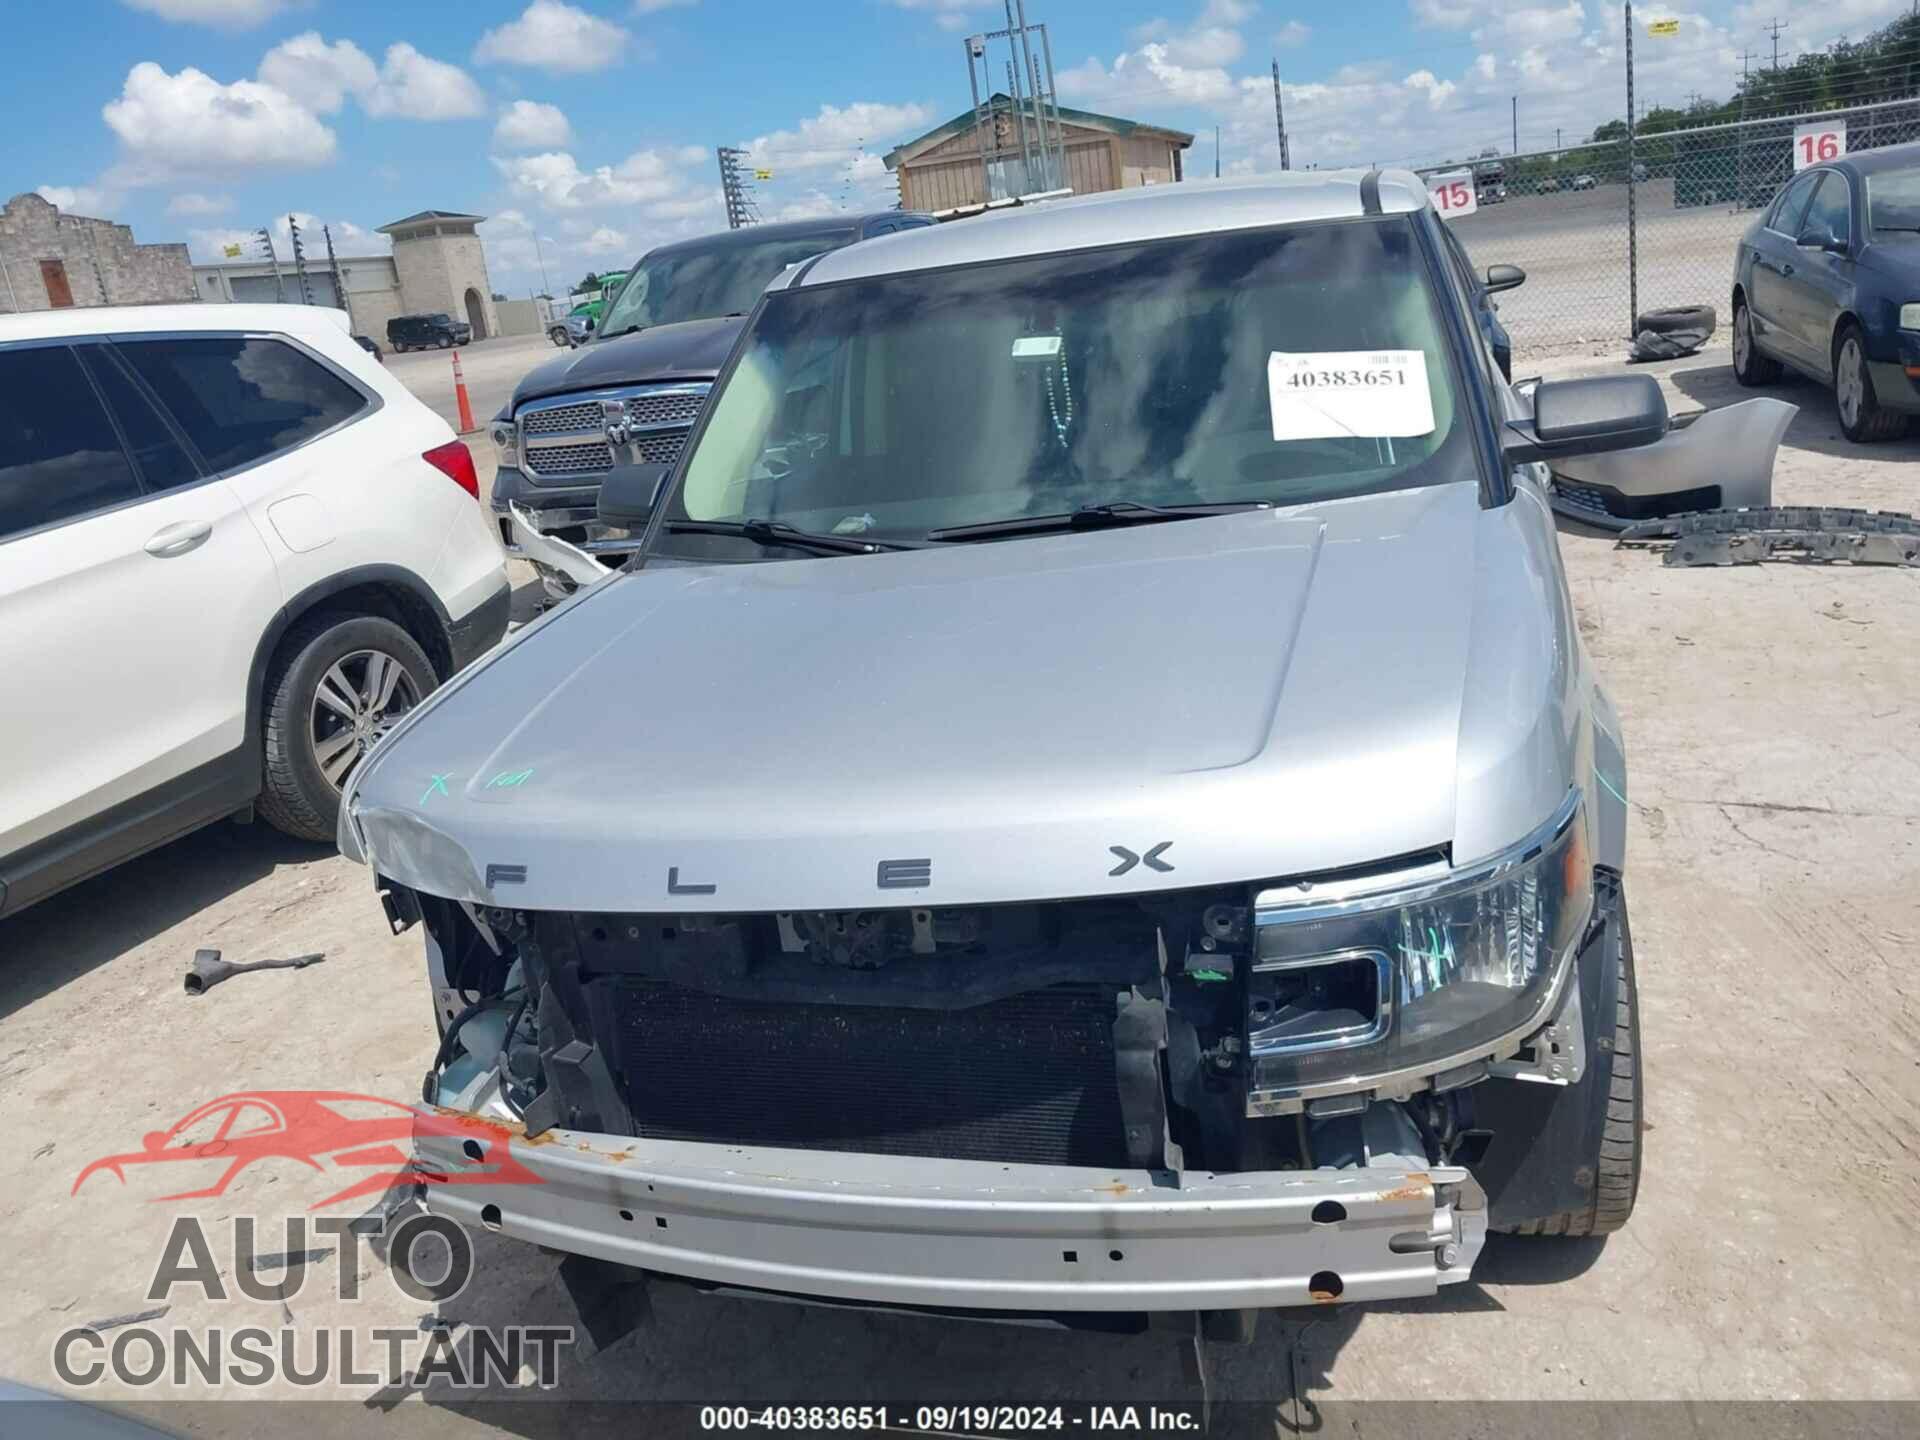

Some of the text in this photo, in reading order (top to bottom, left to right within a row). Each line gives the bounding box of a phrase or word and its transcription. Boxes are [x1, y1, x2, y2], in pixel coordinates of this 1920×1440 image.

[1799, 133, 1838, 163] 16
[1435, 181, 1469, 210] 15
[1286, 369, 1405, 388] 40383651
[485, 840, 1175, 896] FLEX
